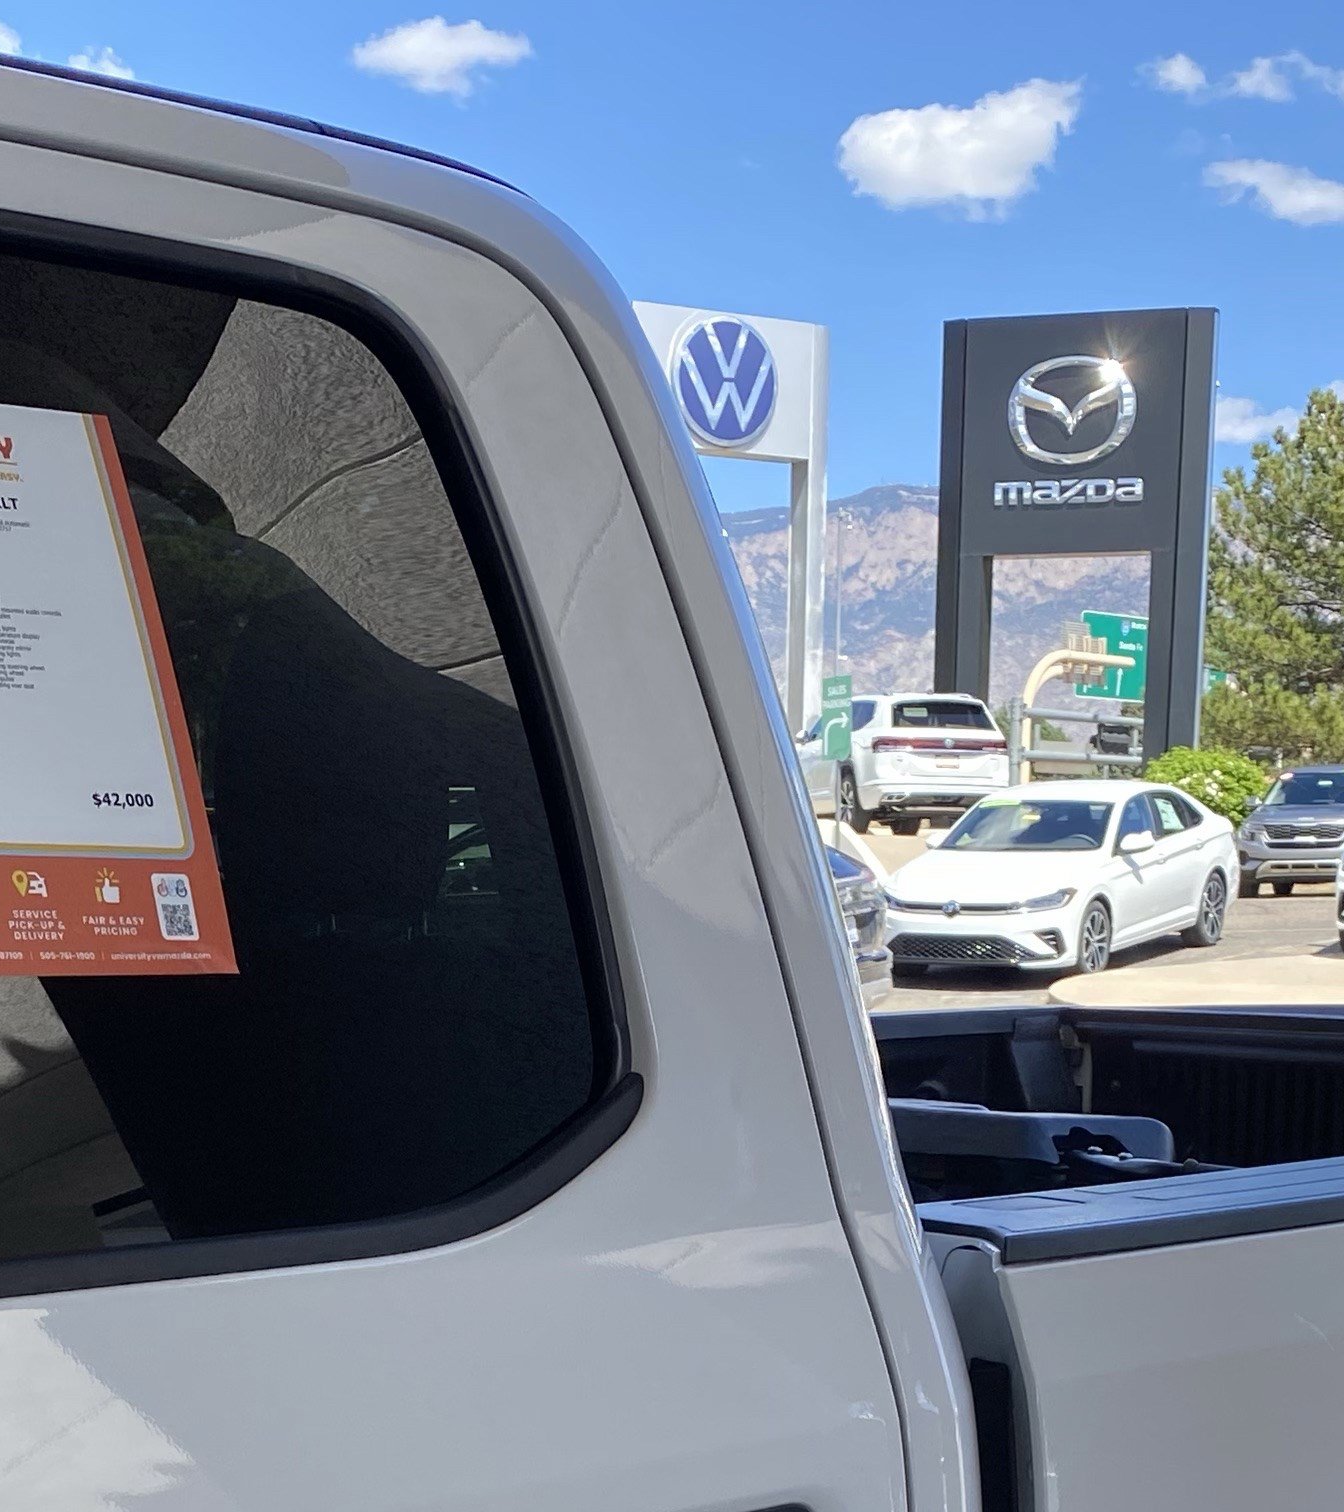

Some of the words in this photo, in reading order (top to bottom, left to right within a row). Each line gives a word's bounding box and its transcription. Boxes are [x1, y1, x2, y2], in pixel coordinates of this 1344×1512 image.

[92, 792, 154, 810] $42,000
[12, 909, 58, 920] SERVICE
[8, 920, 56, 931] PICK-UP
[57, 921, 66, 930] &
[82, 916, 106, 926] FAIR
[108, 917, 117, 926] &
[119, 916, 145, 926] EASY
[14, 931, 64, 941] DELIVERY
[94, 926, 138, 936] PRICING
